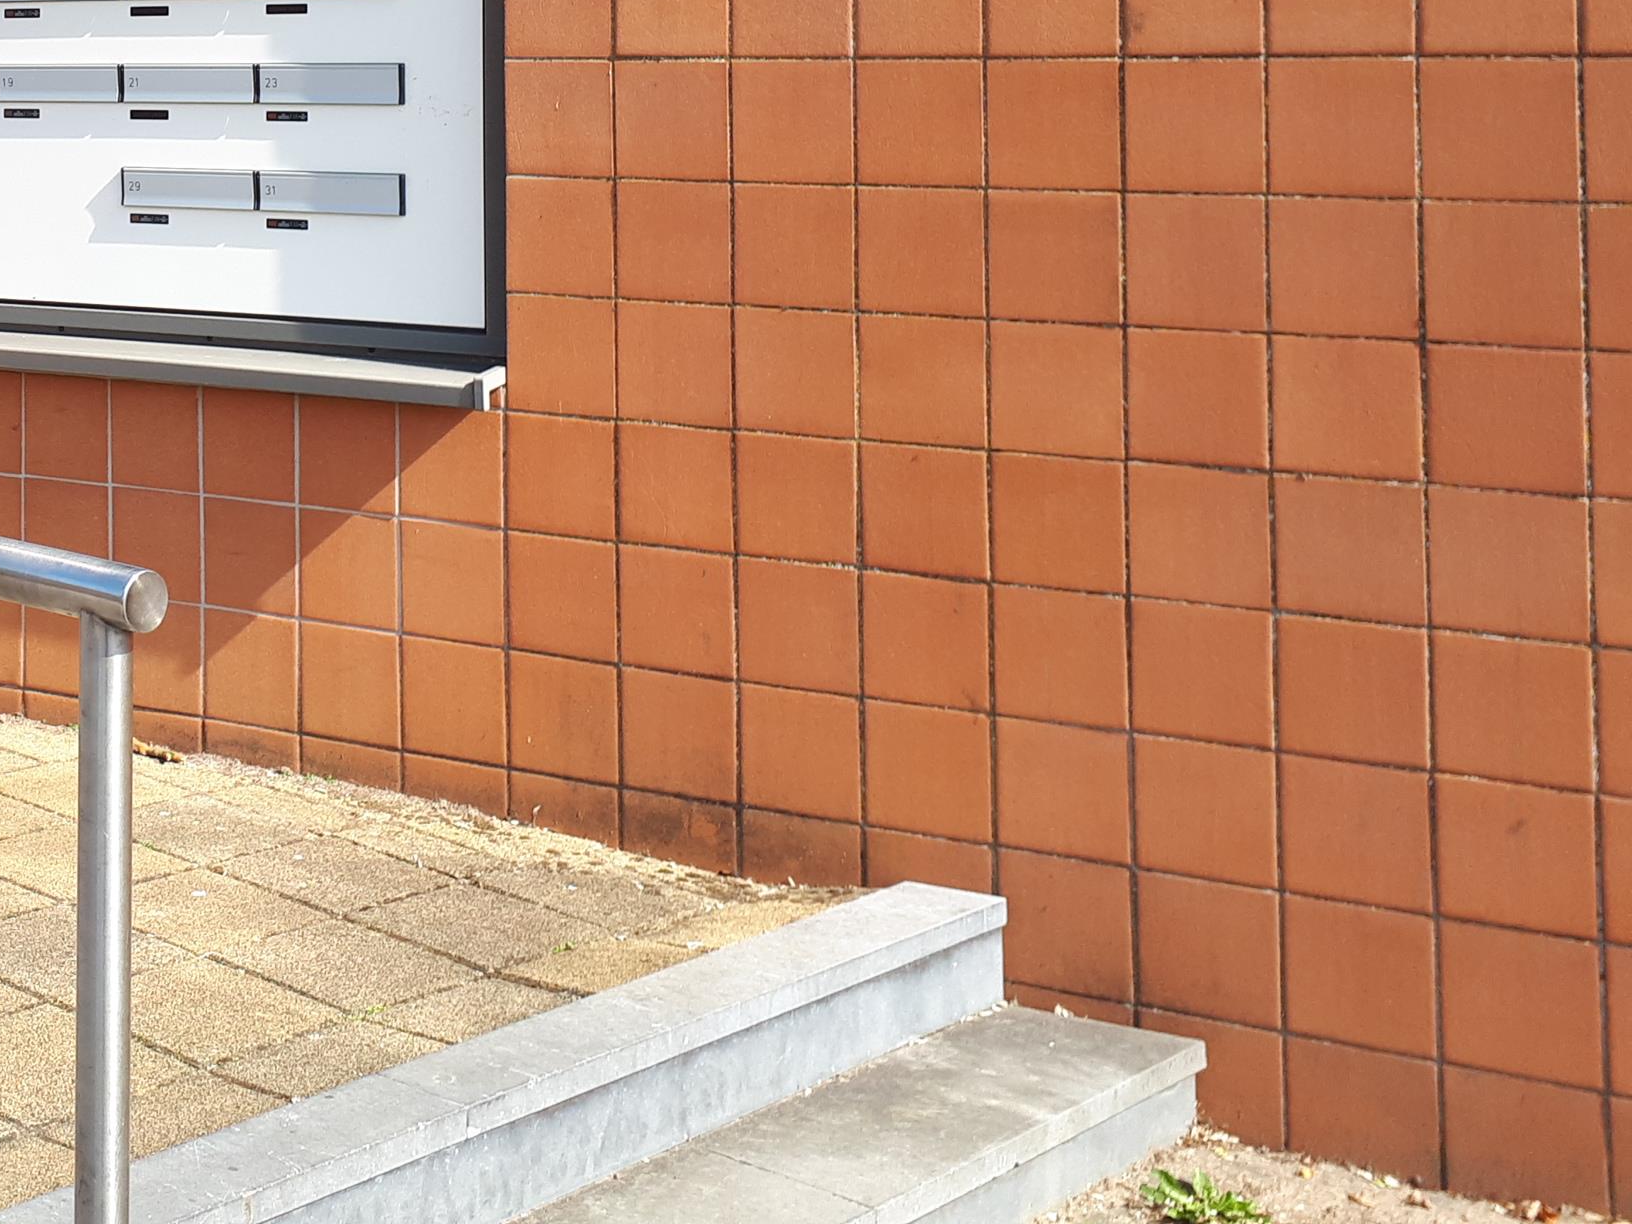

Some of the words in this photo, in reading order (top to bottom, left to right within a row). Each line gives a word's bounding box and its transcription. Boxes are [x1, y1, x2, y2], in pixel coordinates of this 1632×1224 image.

[2, 77, 14, 88] 19
[128, 77, 139, 88] 21
[264, 77, 278, 89] 23
[128, 180, 141, 192] 29
[265, 184, 276, 196] 31
